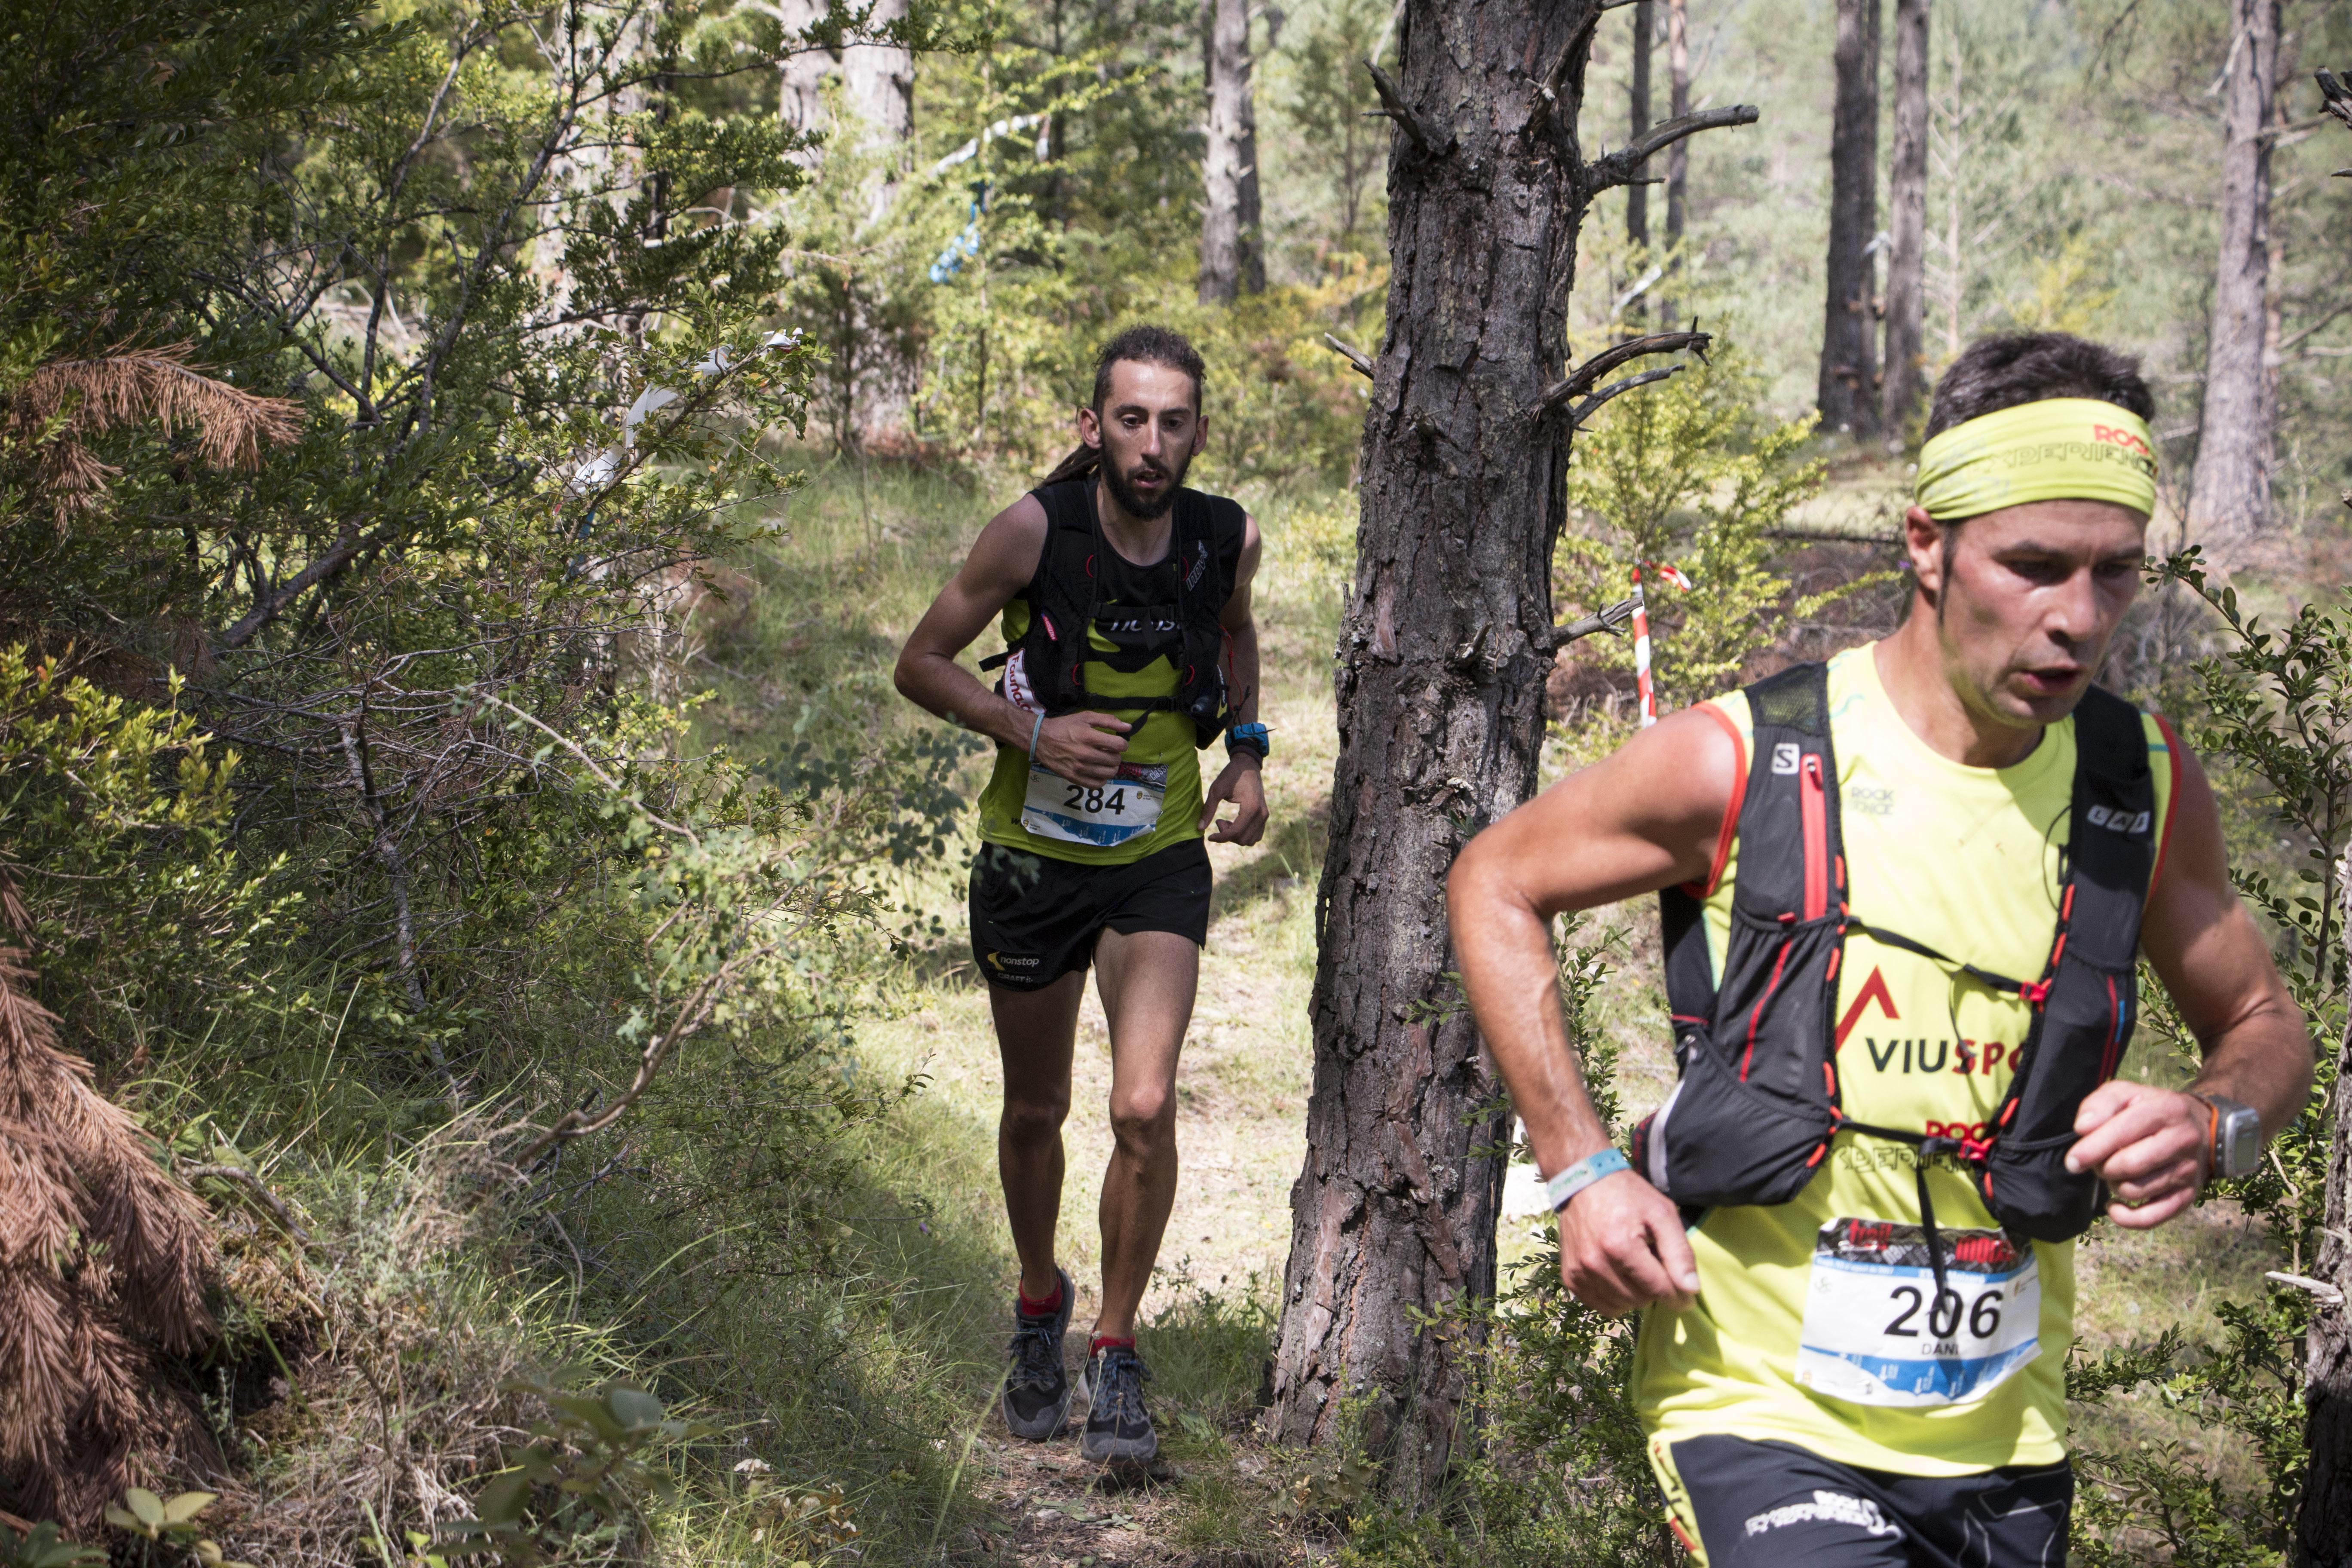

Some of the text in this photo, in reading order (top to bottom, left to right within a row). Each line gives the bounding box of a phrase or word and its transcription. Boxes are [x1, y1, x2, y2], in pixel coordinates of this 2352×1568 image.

[1064, 784, 1125, 815] 284
[1000, 956, 1039, 967] nonstop
[1883, 1285, 2004, 1339] 206
[1922, 1342, 1960, 1355] DANI
